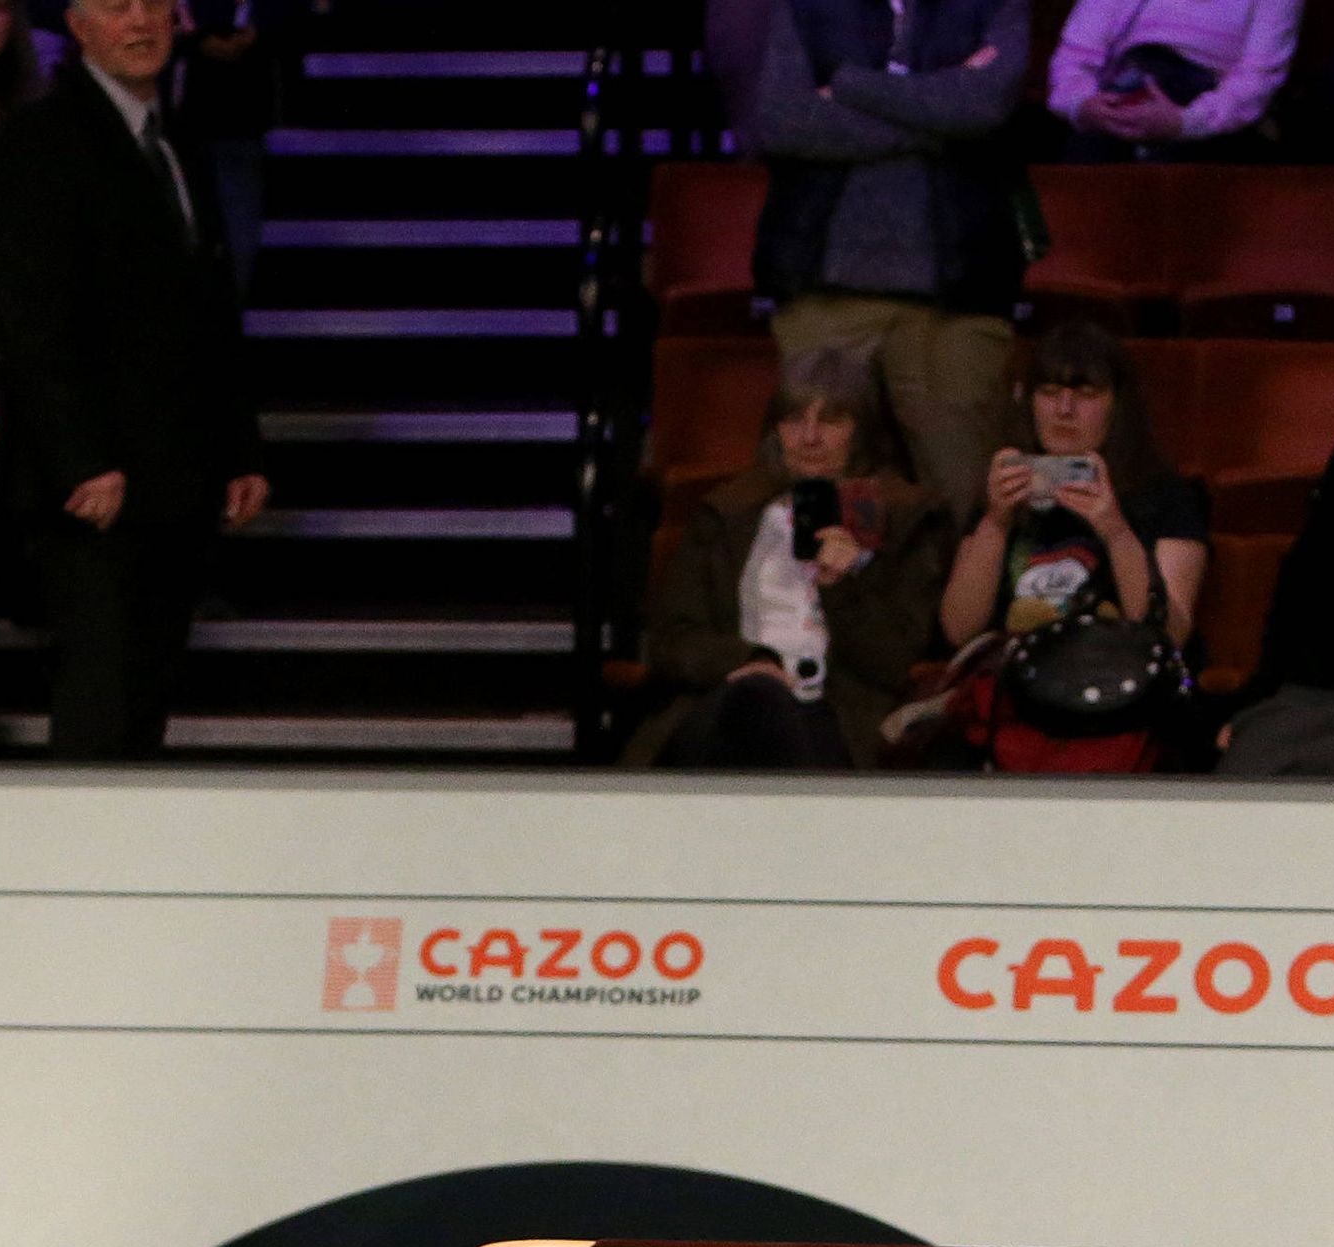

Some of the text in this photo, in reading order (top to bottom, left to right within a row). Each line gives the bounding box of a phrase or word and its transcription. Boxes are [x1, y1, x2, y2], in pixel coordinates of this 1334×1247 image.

[419, 928, 704, 981] CAZOO
[416, 983, 702, 1006] WORLD CHAMPIONSHIP
